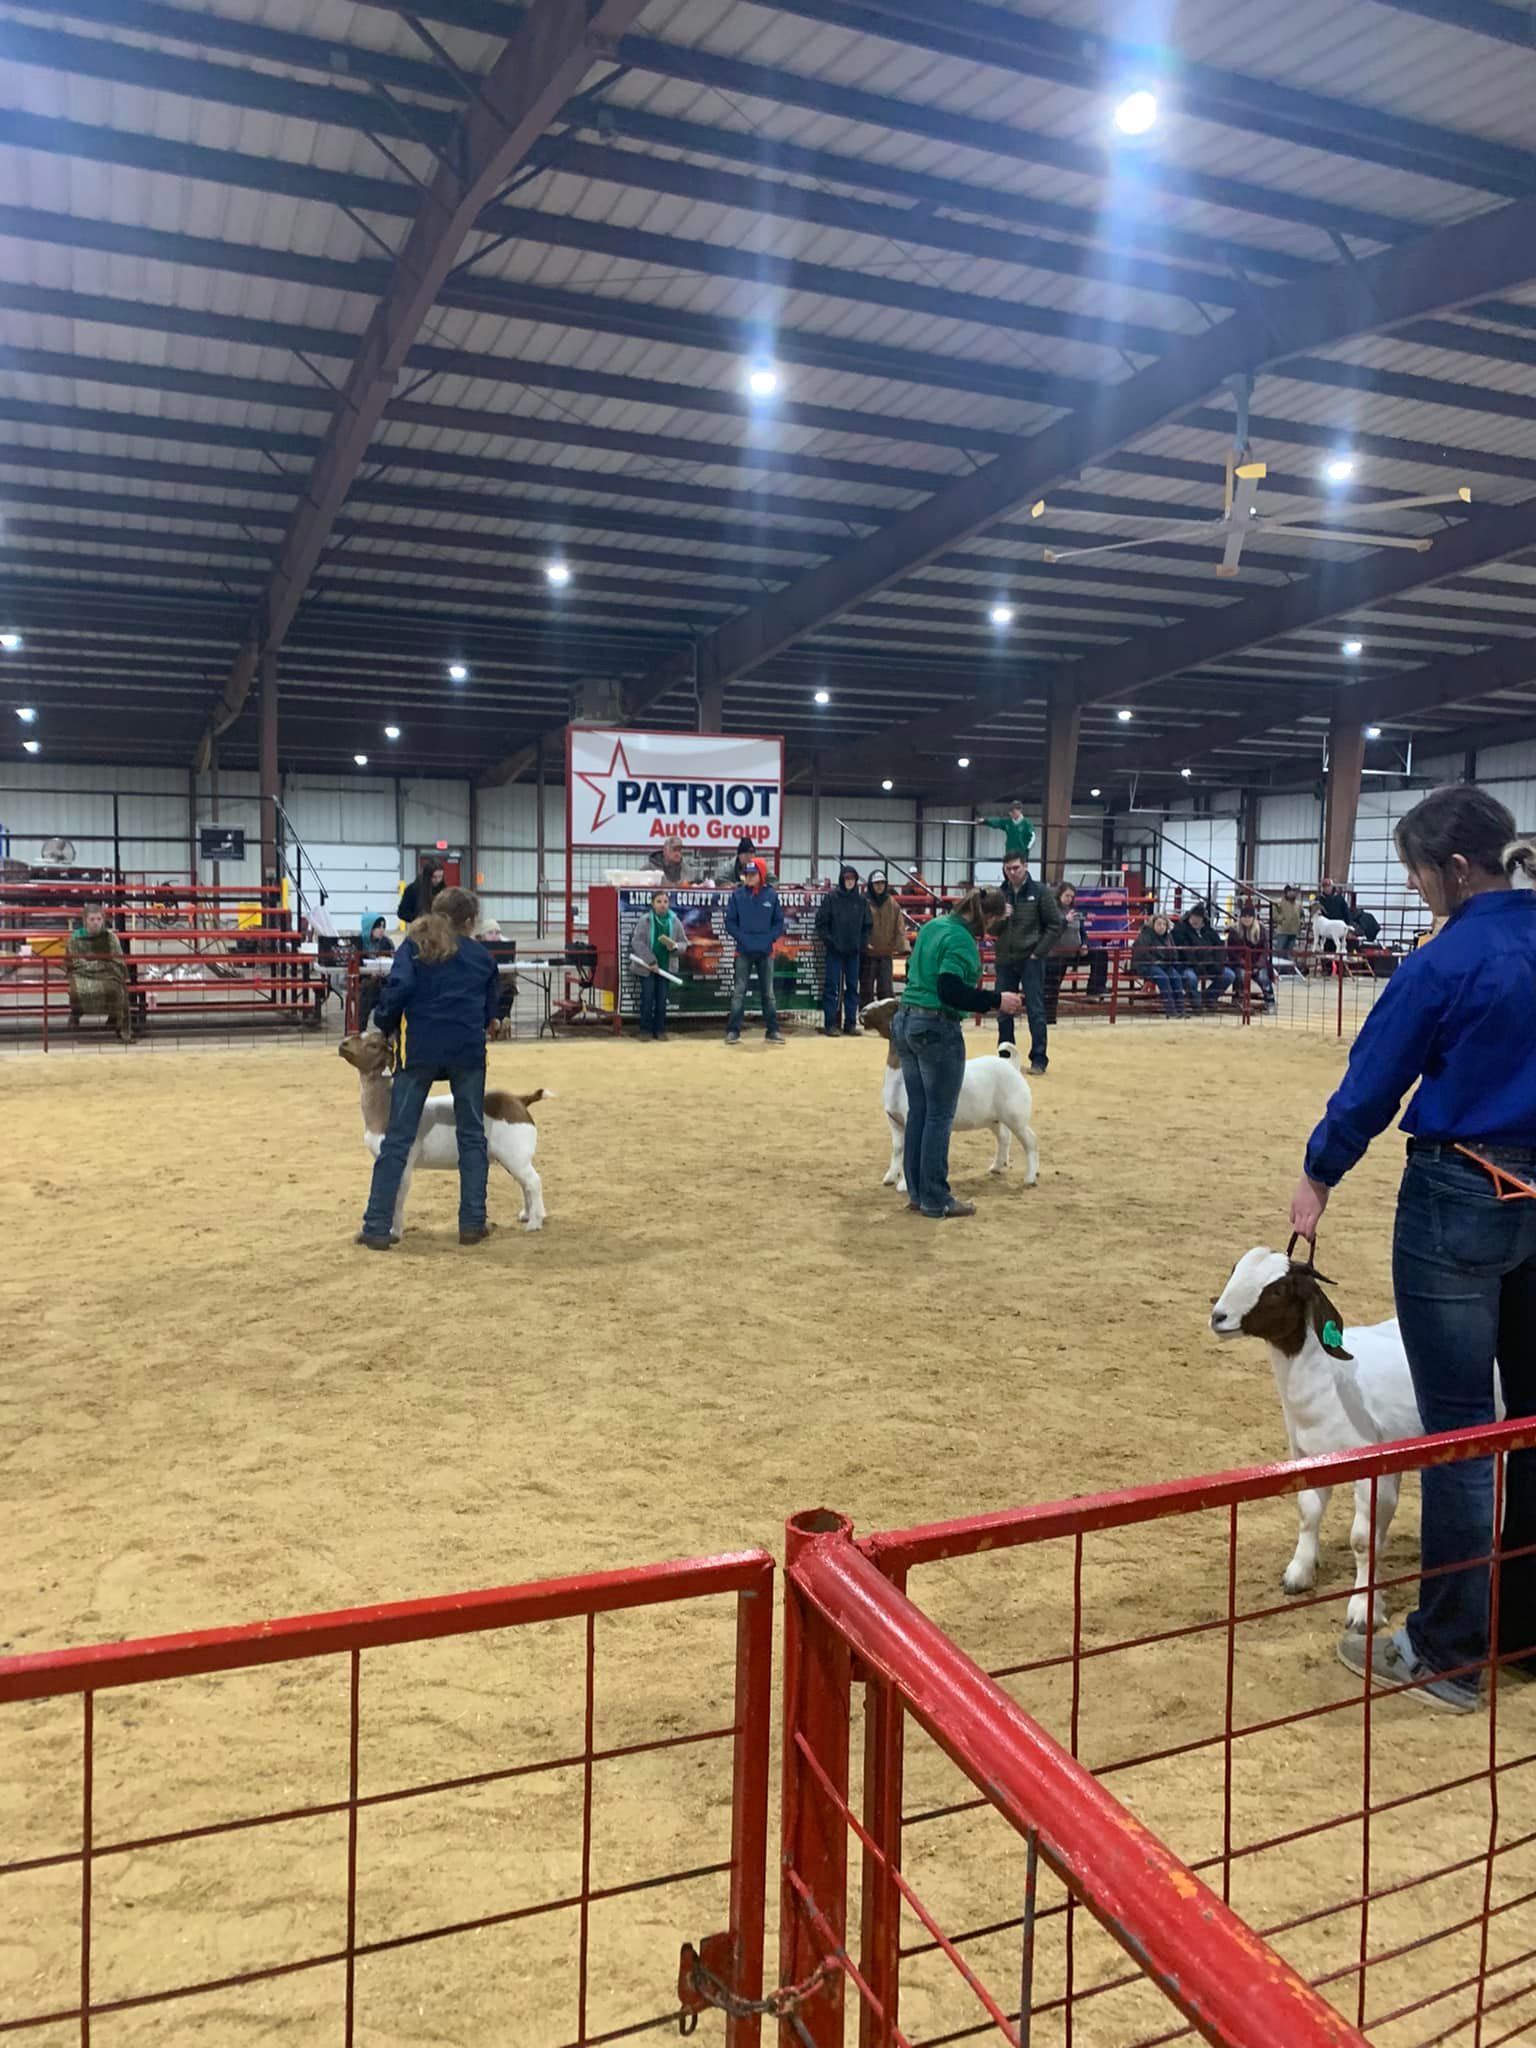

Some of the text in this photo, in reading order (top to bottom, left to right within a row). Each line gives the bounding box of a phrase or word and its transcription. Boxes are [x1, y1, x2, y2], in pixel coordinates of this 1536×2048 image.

[617, 781, 778, 816] PATRIOT
[650, 818, 770, 843] Auto Group
[676, 891, 713, 906] COUNTY
